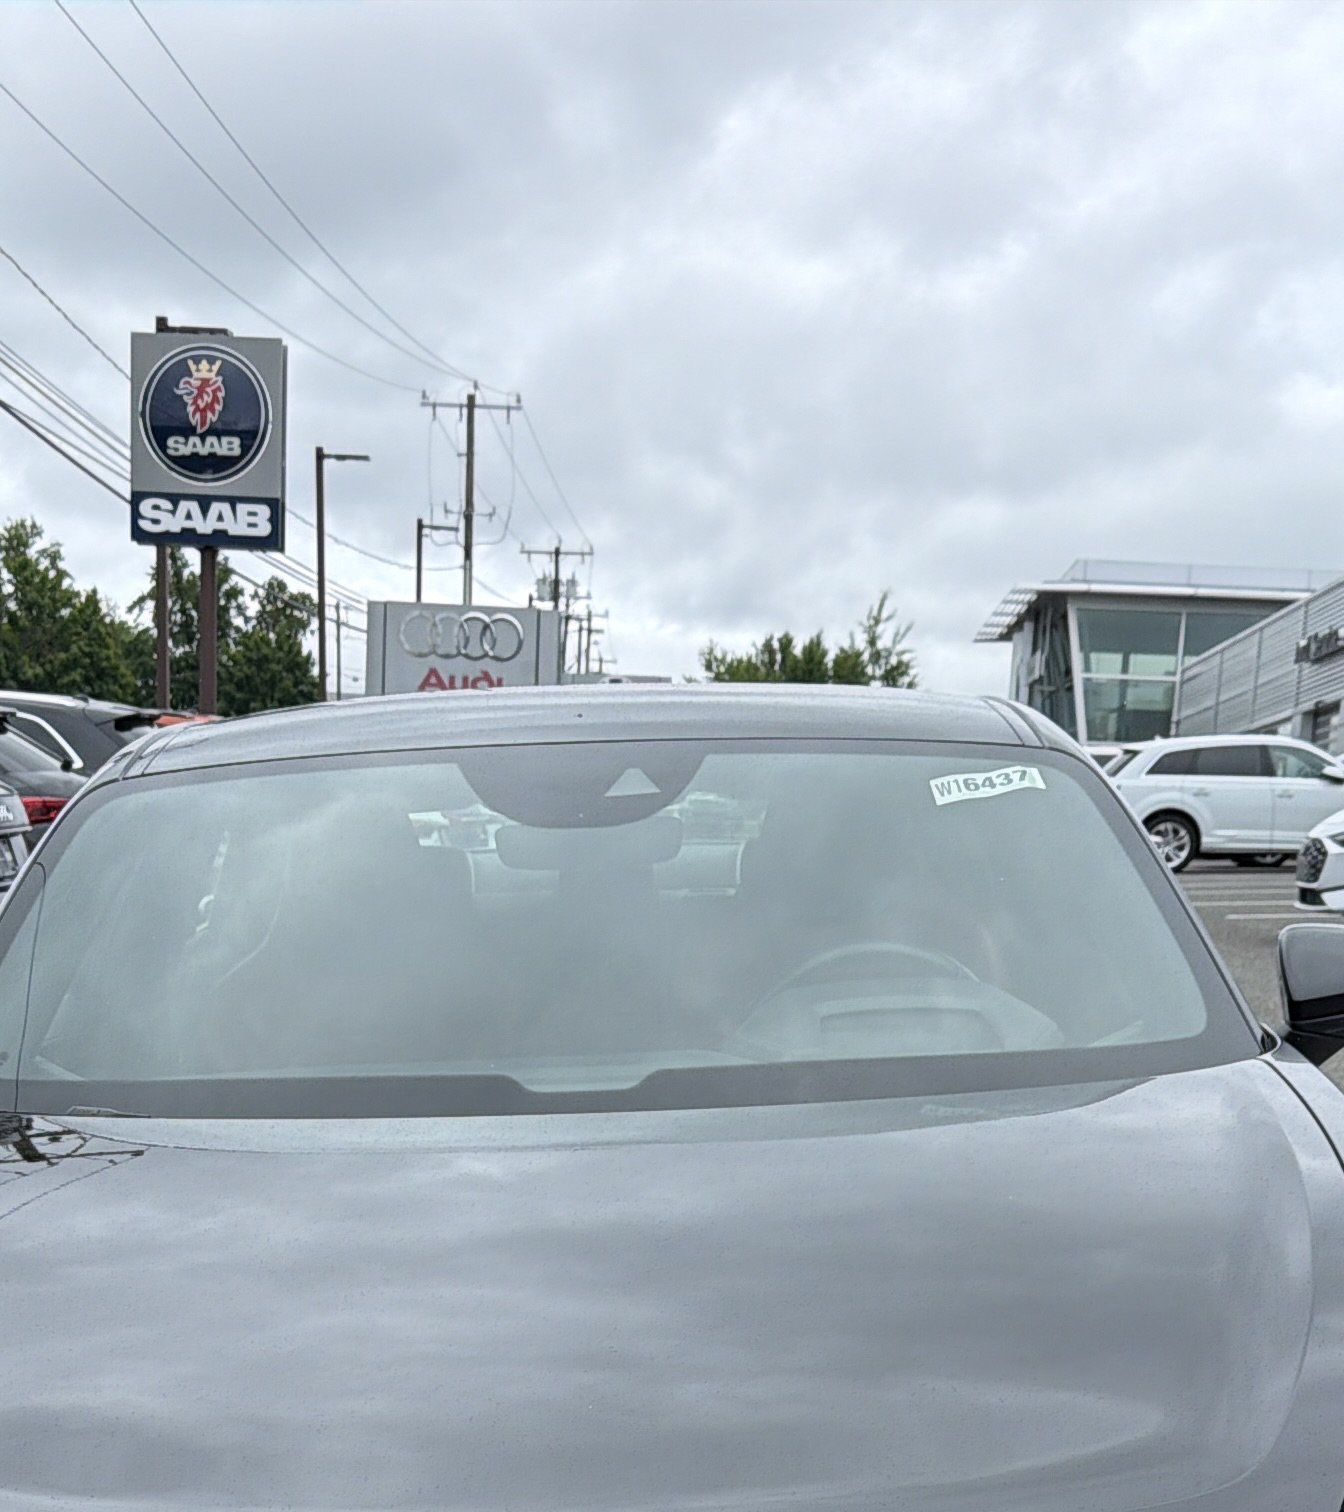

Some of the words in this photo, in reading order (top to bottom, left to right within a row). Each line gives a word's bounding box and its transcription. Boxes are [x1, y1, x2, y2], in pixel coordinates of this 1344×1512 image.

[166, 436, 241, 457] SAAB
[138, 497, 272, 538] SAAB
[935, 769, 1028, 798] W16437
